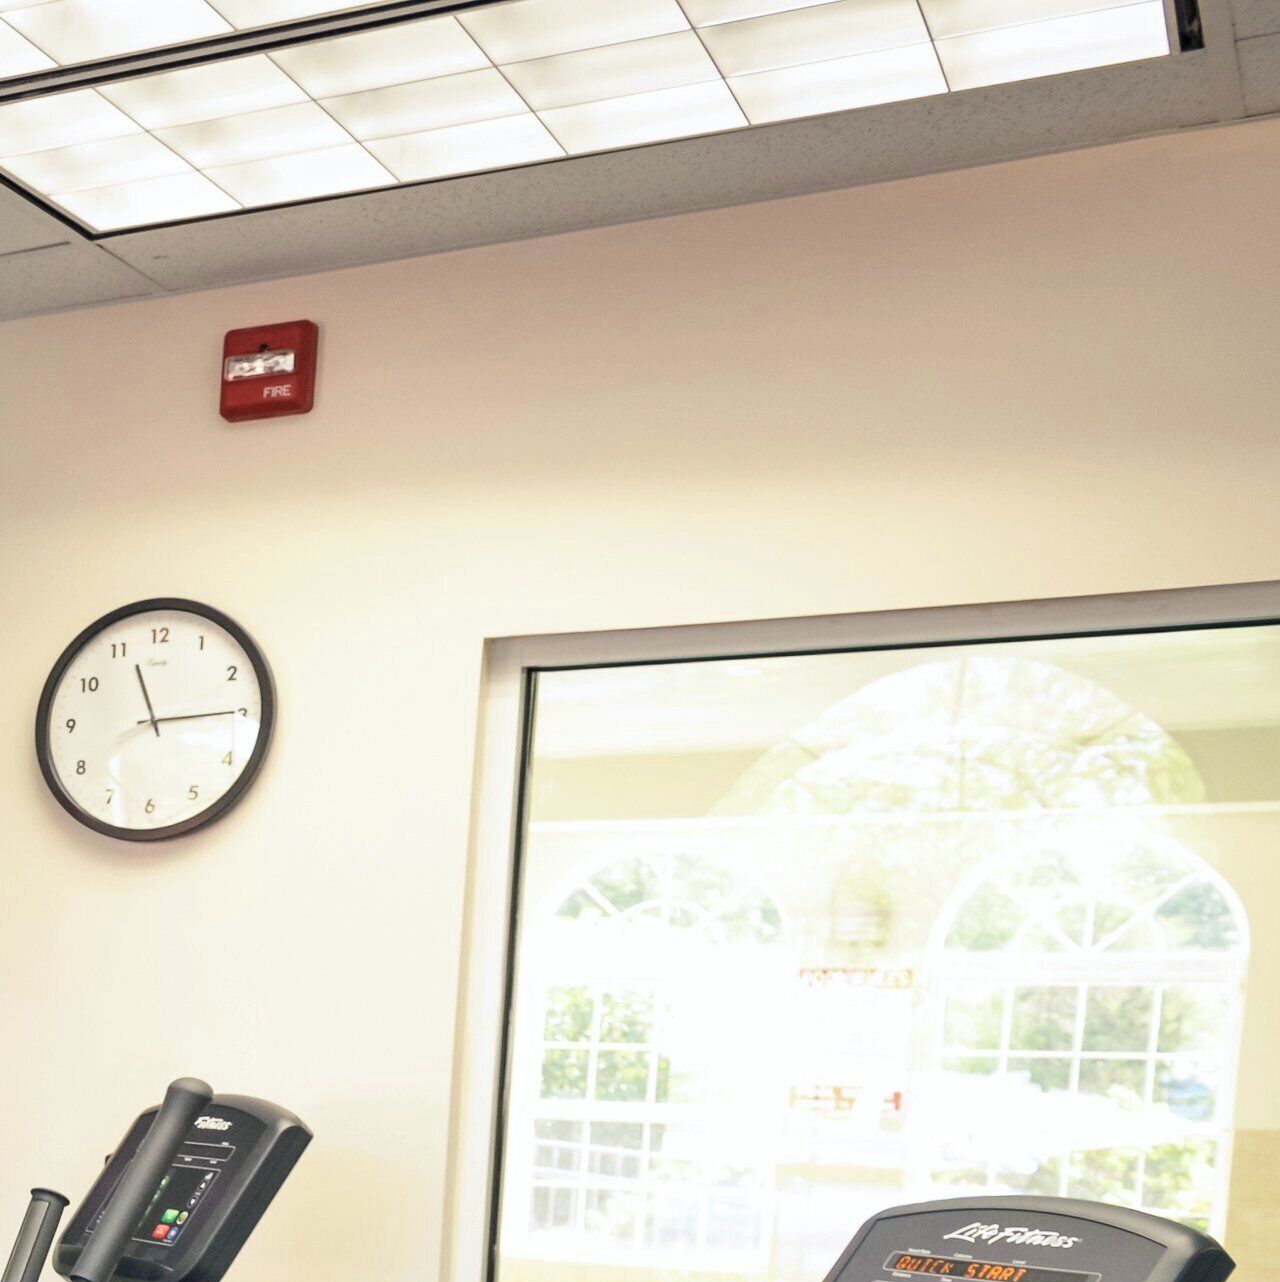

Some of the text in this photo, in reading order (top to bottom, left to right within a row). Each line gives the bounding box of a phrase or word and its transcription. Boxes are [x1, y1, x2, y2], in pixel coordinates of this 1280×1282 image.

[263, 384, 291, 398] FIRE
[151, 627, 169, 644] 12
[198, 635, 205, 650] 1
[110, 642, 127, 658] 11
[227, 665, 237, 681] 2
[80, 676, 99, 693] 10
[66, 718, 76, 734] 9
[221, 751, 233, 766] 4
[76, 760, 86, 775] 8
[105, 788, 115, 804] 7
[188, 785, 199, 801] 5
[144, 798, 156, 814] 6
[895, 1255, 1027, 1282] QUICK START
